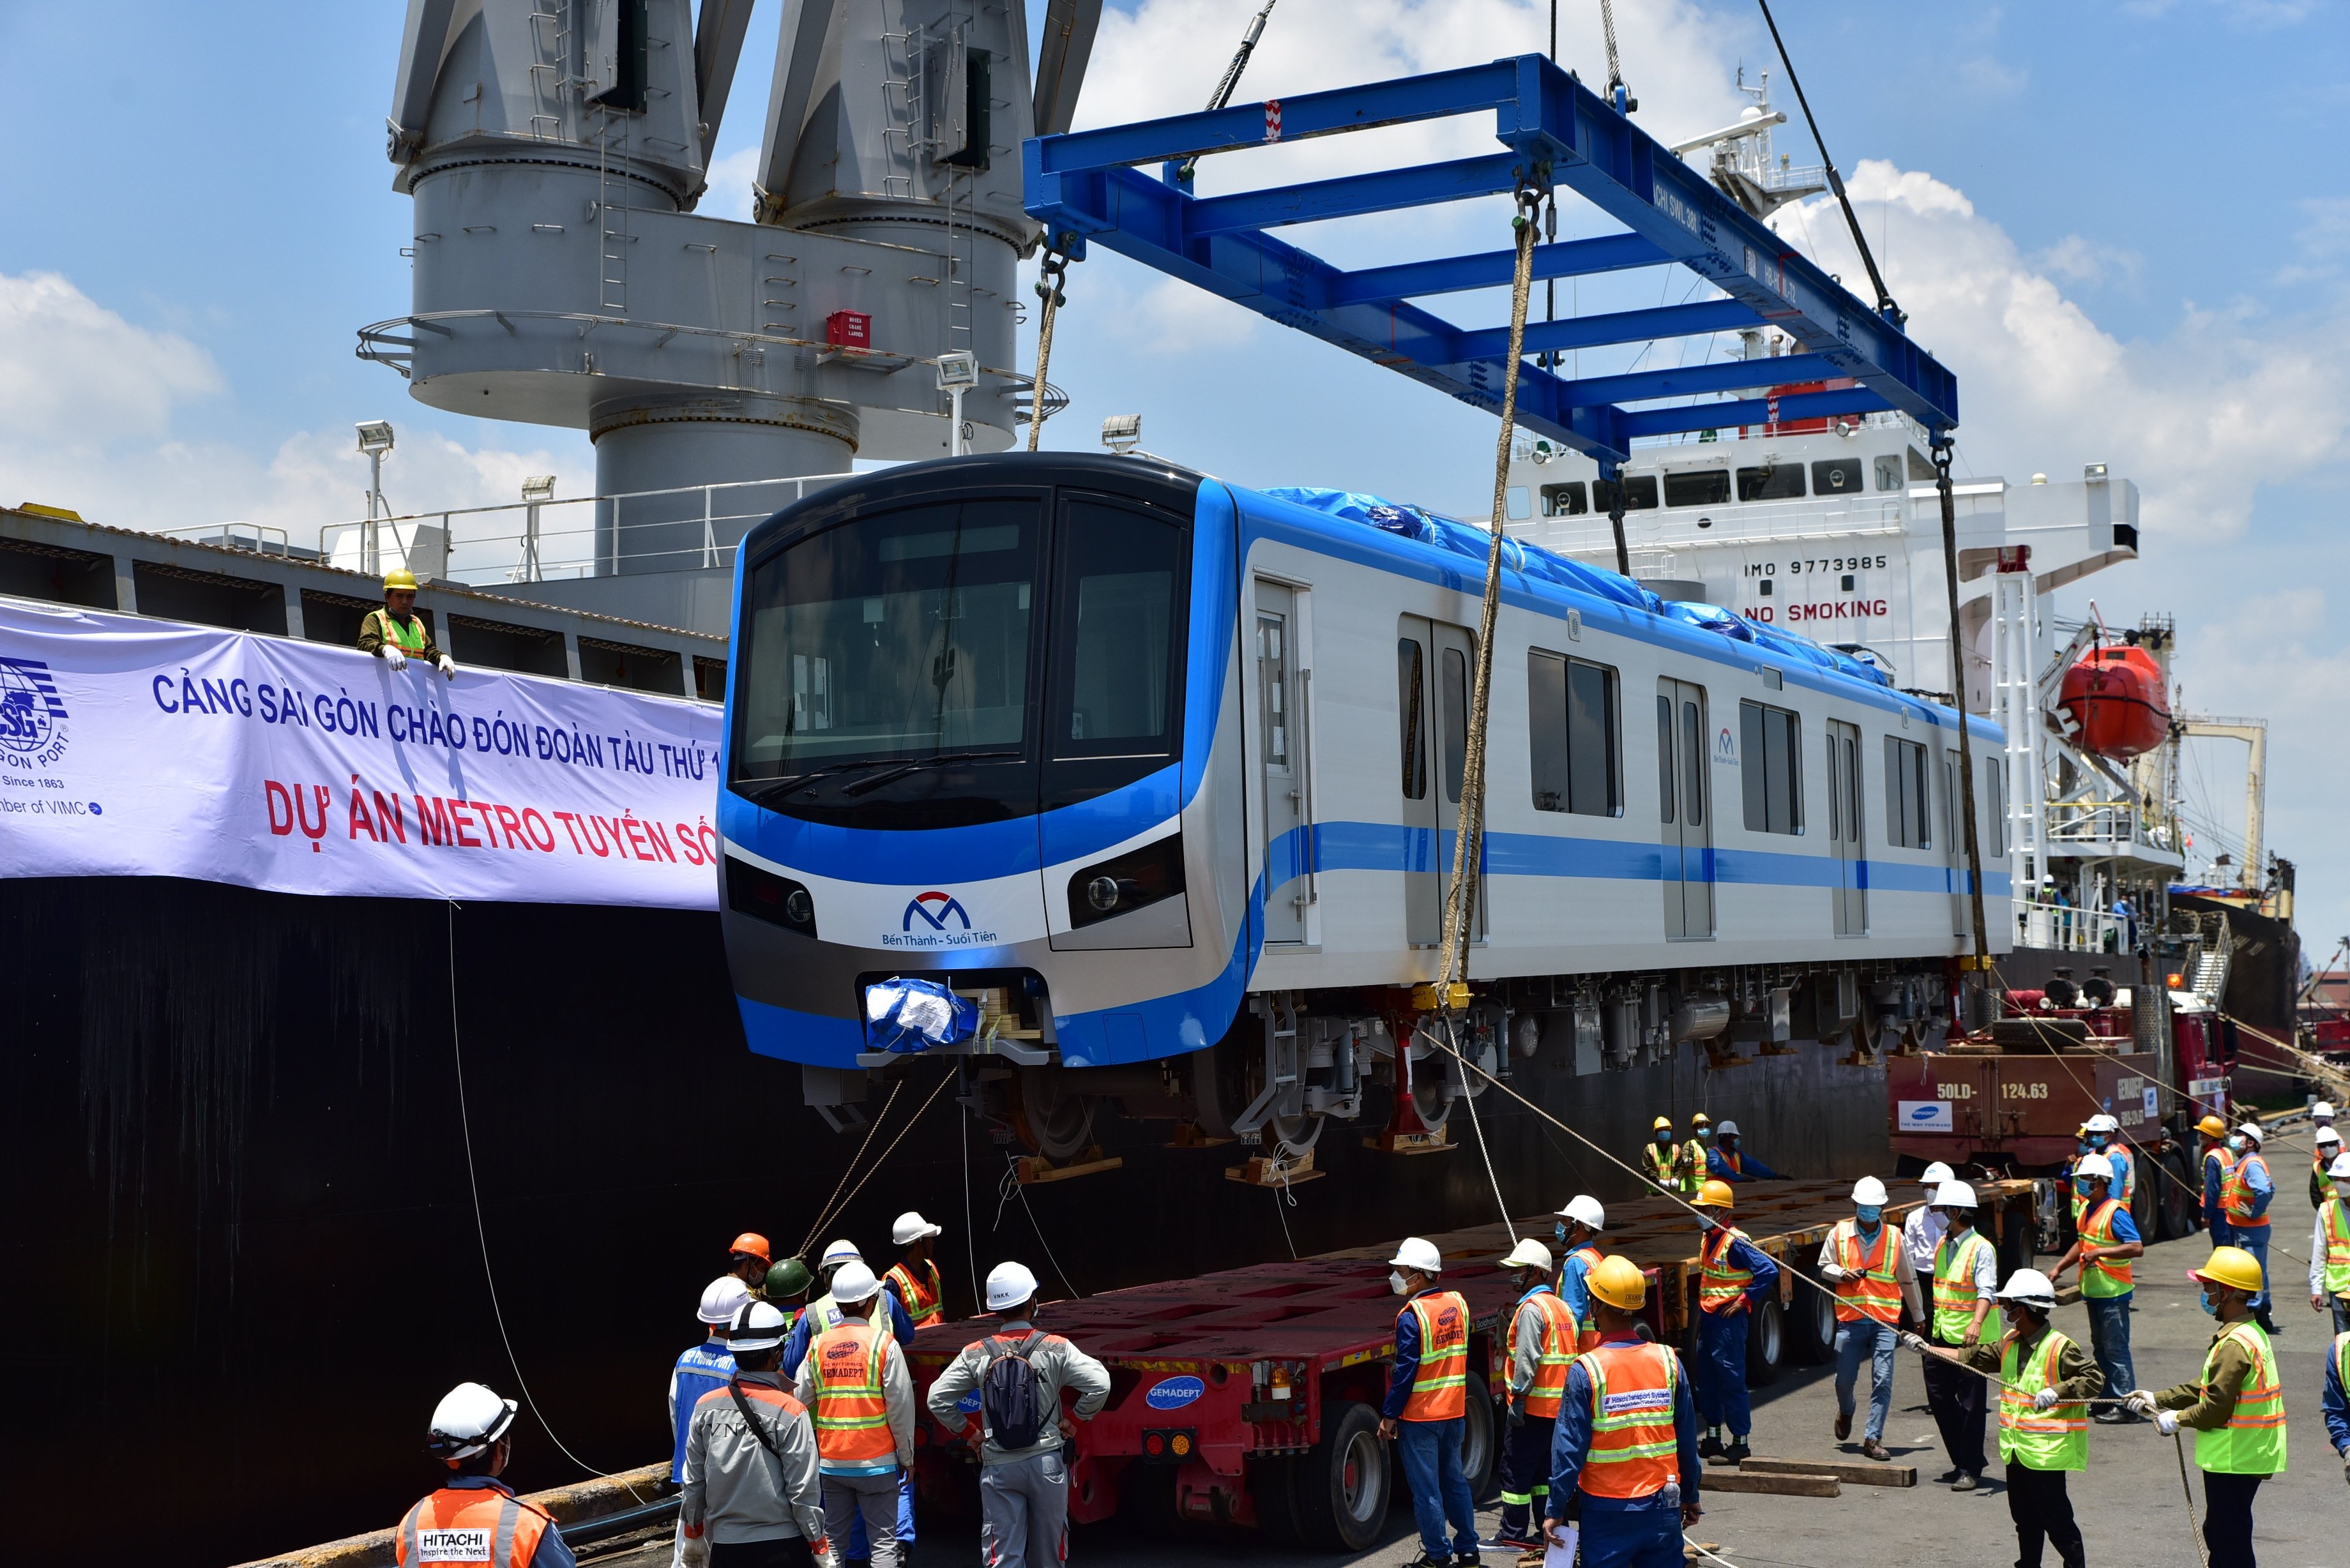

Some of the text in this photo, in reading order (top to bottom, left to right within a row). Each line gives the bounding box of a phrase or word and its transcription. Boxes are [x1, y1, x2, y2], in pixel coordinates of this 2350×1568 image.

[1669, 195, 1686, 225] SWL
[1745, 555, 1886, 577] IMO 9773985
[1745, 599, 1887, 622] NO SMOKING
[153, 667, 253, 718] CẢNG
[259, 677, 309, 727] SÀI
[314, 687, 380, 739] GÒN
[387, 700, 467, 750] CHÀO
[473, 711, 531, 758] ĐÓN
[535, 721, 603, 769] ĐOÀN
[607, 730, 654, 774] TÀU
[658, 739, 706, 781] THỨ
[37, 732, 69, 767] PORT
[3, 775, 64, 789] Since 1863
[31, 800, 45, 814] of
[46, 801, 86, 816] VIMC
[264, 780, 331, 853] DỰ
[349, 774, 407, 845] ÁN
[414, 794, 556, 854] METRO
[552, 808, 678, 864] TUYẾN
[883, 933, 902, 946] Bến
[903, 935, 937, 946] Thành
[946, 931, 971, 945] Suối
[971, 931, 997, 943] Tiên
[1937, 1083, 2049, 1099] 50LD- 124.63
[1476, 1317, 1497, 1329] Goldhofer
[1150, 1388, 1201, 1398] GEMADEPT
[423, 1534, 483, 1547] HITACHI
[420, 1546, 487, 1558] Inspire the Next
